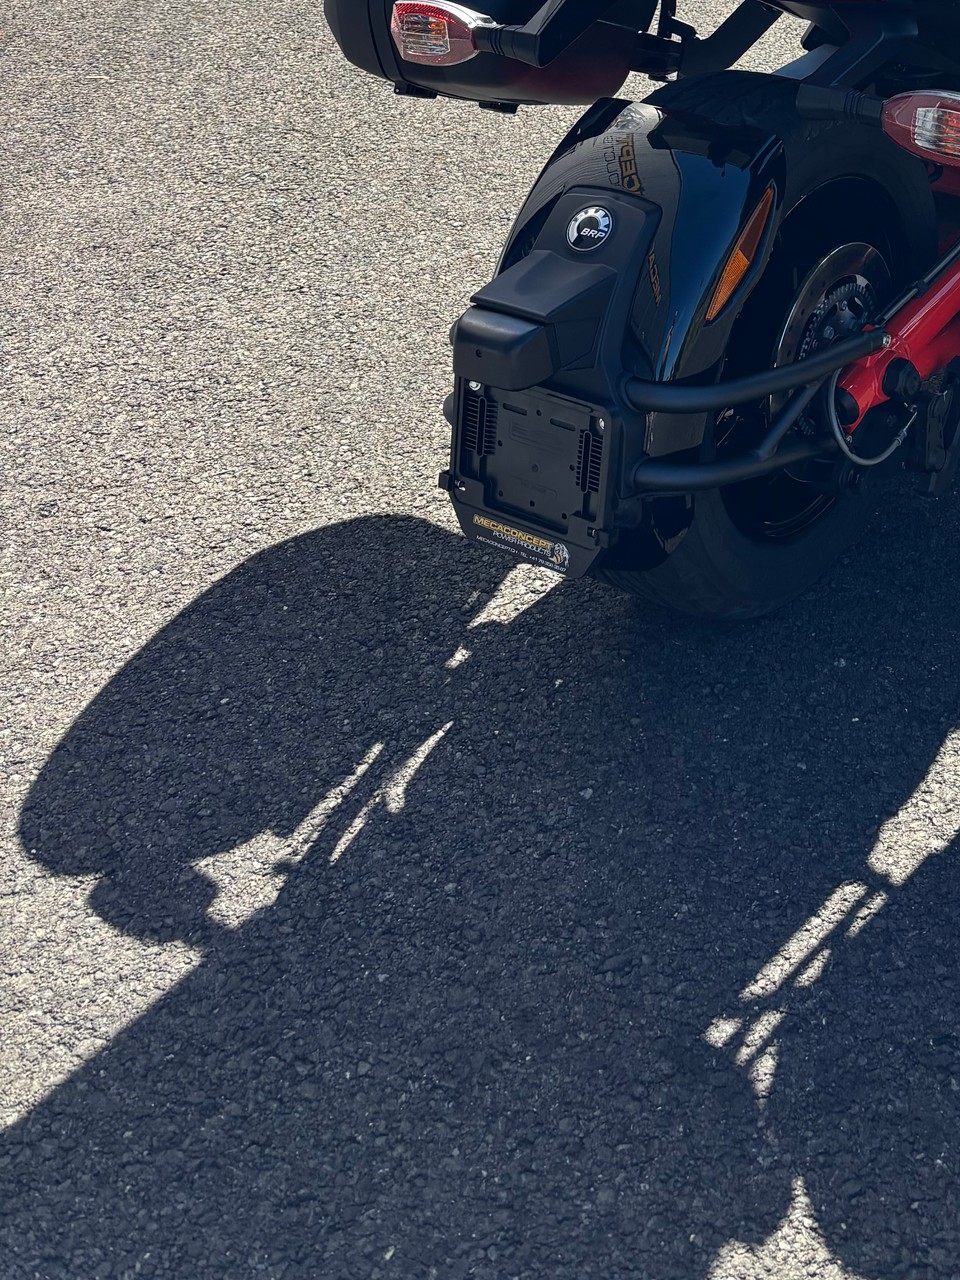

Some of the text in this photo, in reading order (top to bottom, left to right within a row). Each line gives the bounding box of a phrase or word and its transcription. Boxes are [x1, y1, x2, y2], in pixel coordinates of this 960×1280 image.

[580, 227, 606, 239] BRP
[473, 514, 553, 550] MECACONCEPT
[493, 530, 552, 557] POWER PRODUCTS
